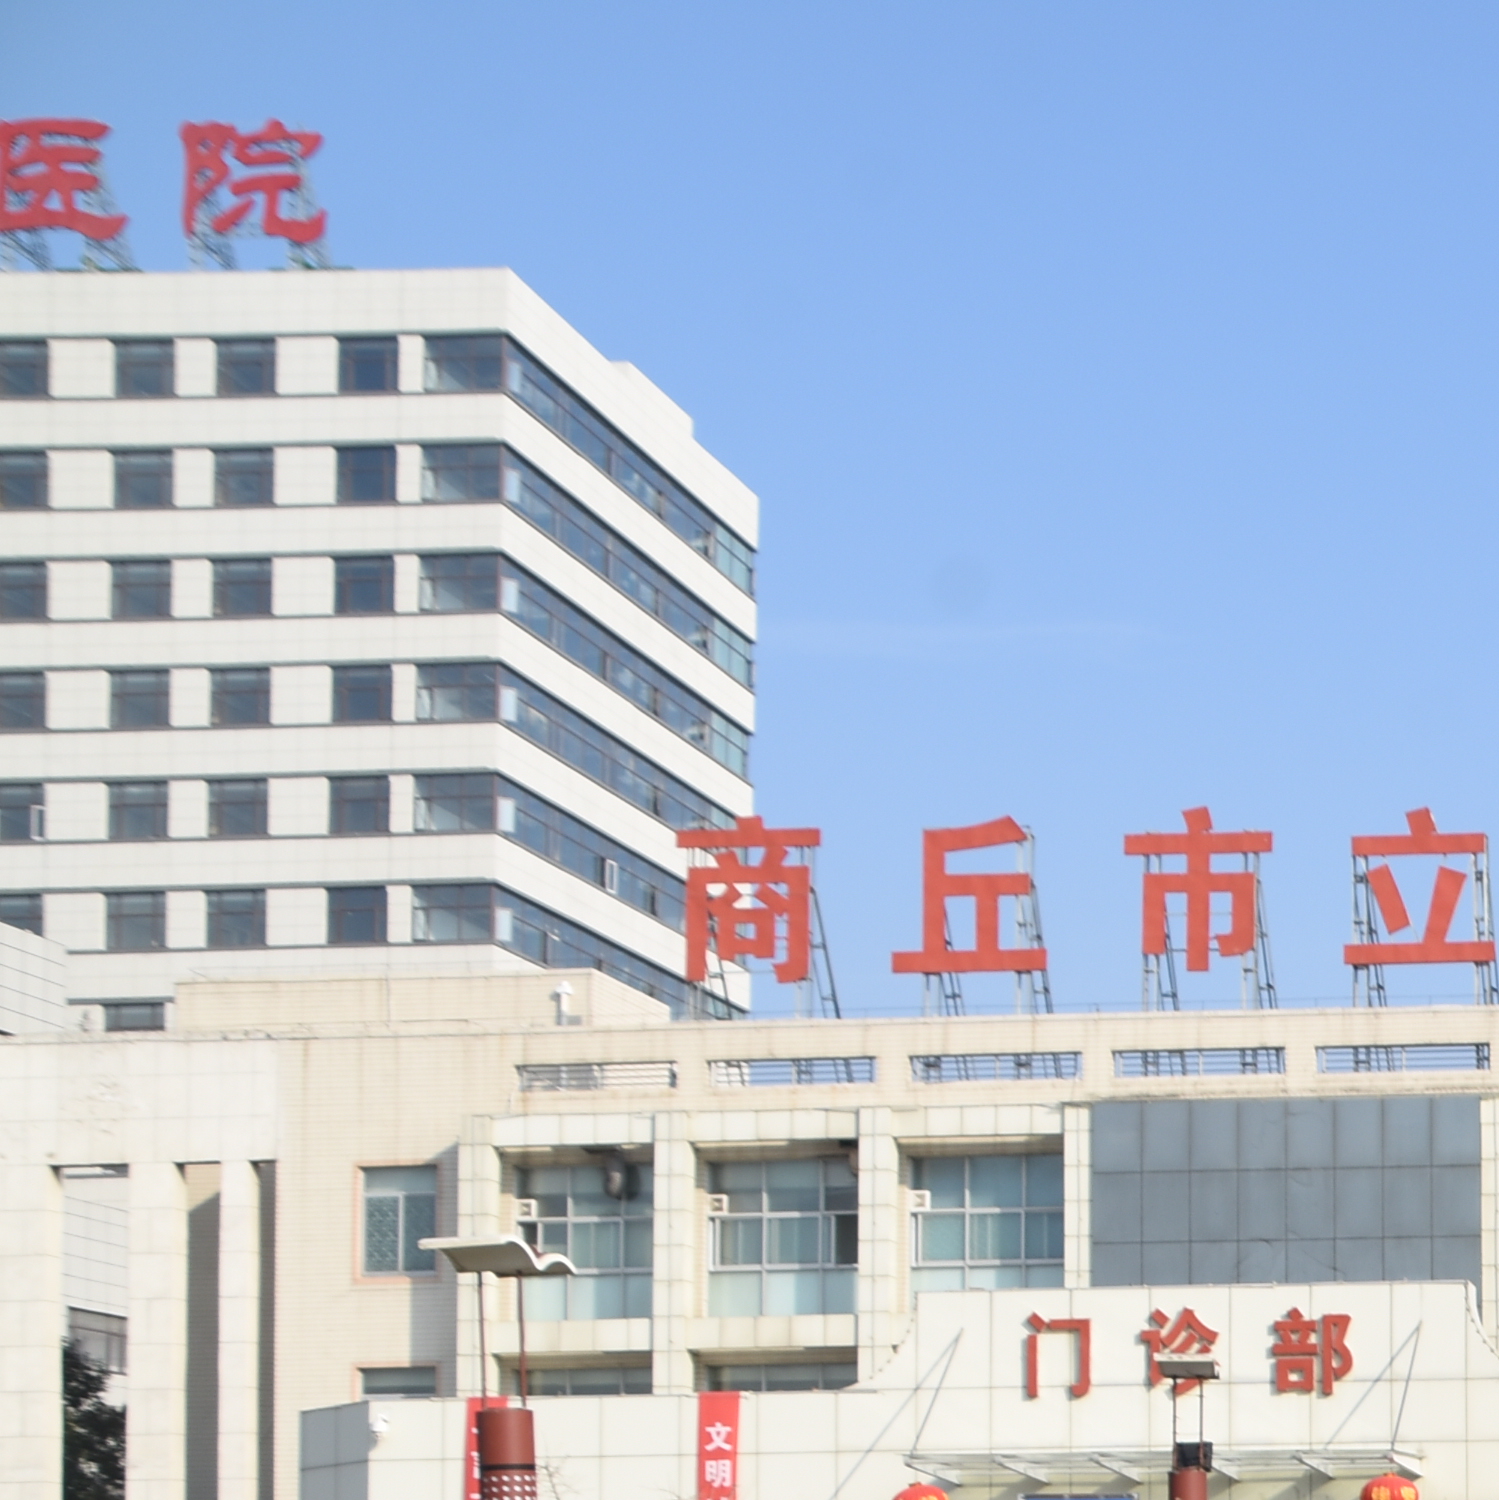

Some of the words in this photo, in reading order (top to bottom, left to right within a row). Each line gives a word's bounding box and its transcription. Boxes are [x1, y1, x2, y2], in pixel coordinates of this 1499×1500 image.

[0, 117, 328, 245] 医院
[1026, 1305, 1354, 1399] 门诊部
